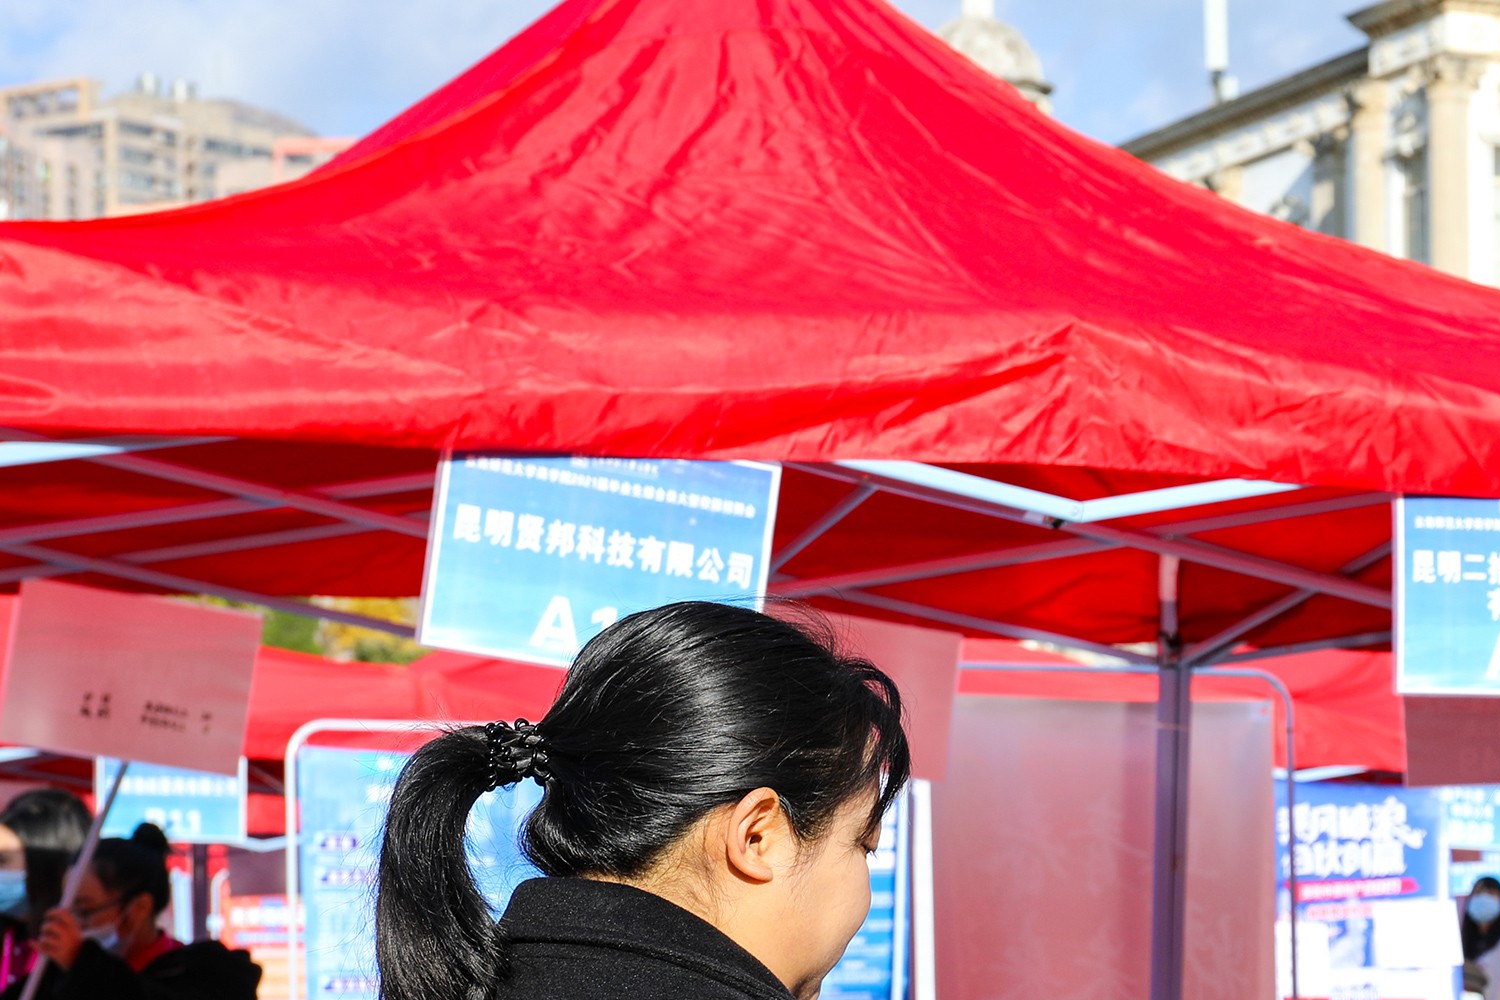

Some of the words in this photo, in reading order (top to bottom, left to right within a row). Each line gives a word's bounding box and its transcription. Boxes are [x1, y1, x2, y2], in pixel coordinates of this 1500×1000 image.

[453, 503, 754, 589] 昆明贤邦科技有限公司
